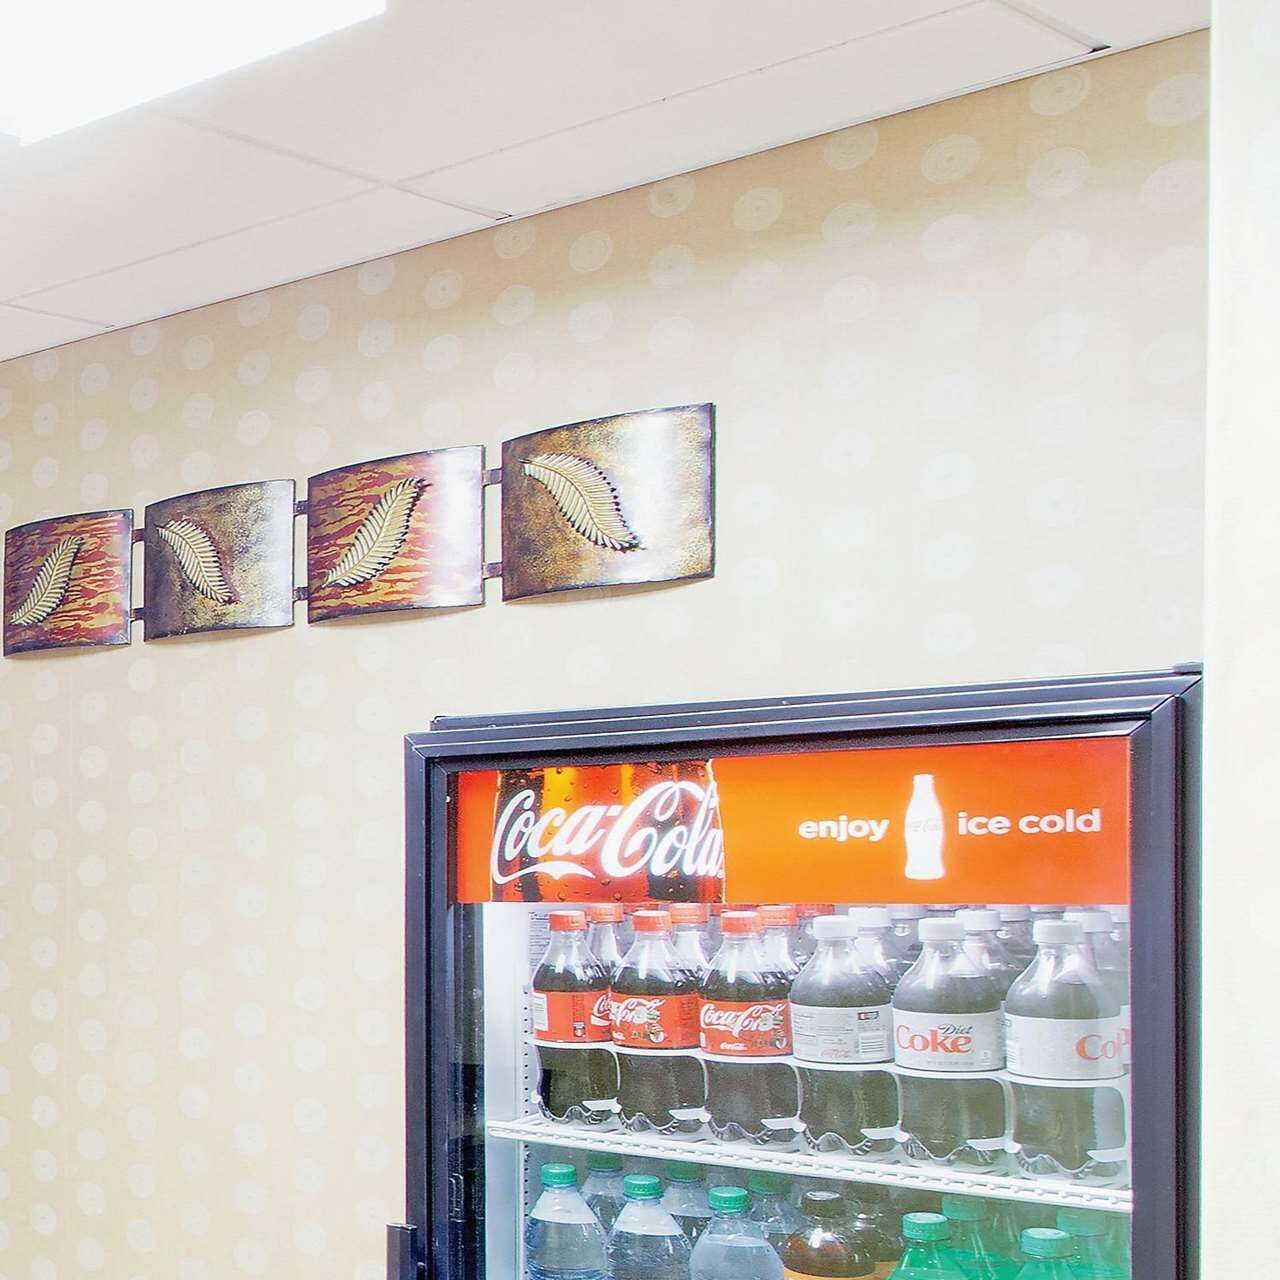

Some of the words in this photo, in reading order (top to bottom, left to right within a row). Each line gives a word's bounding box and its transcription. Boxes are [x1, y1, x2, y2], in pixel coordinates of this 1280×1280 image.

[493, 781, 727, 883] Coca-Cola
[798, 815, 889, 843] enjoy
[957, 811, 1010, 837] ice
[1018, 808, 1101, 836] cold
[896, 1024, 974, 1054] Coke
[938, 1024, 973, 1036] Diet
